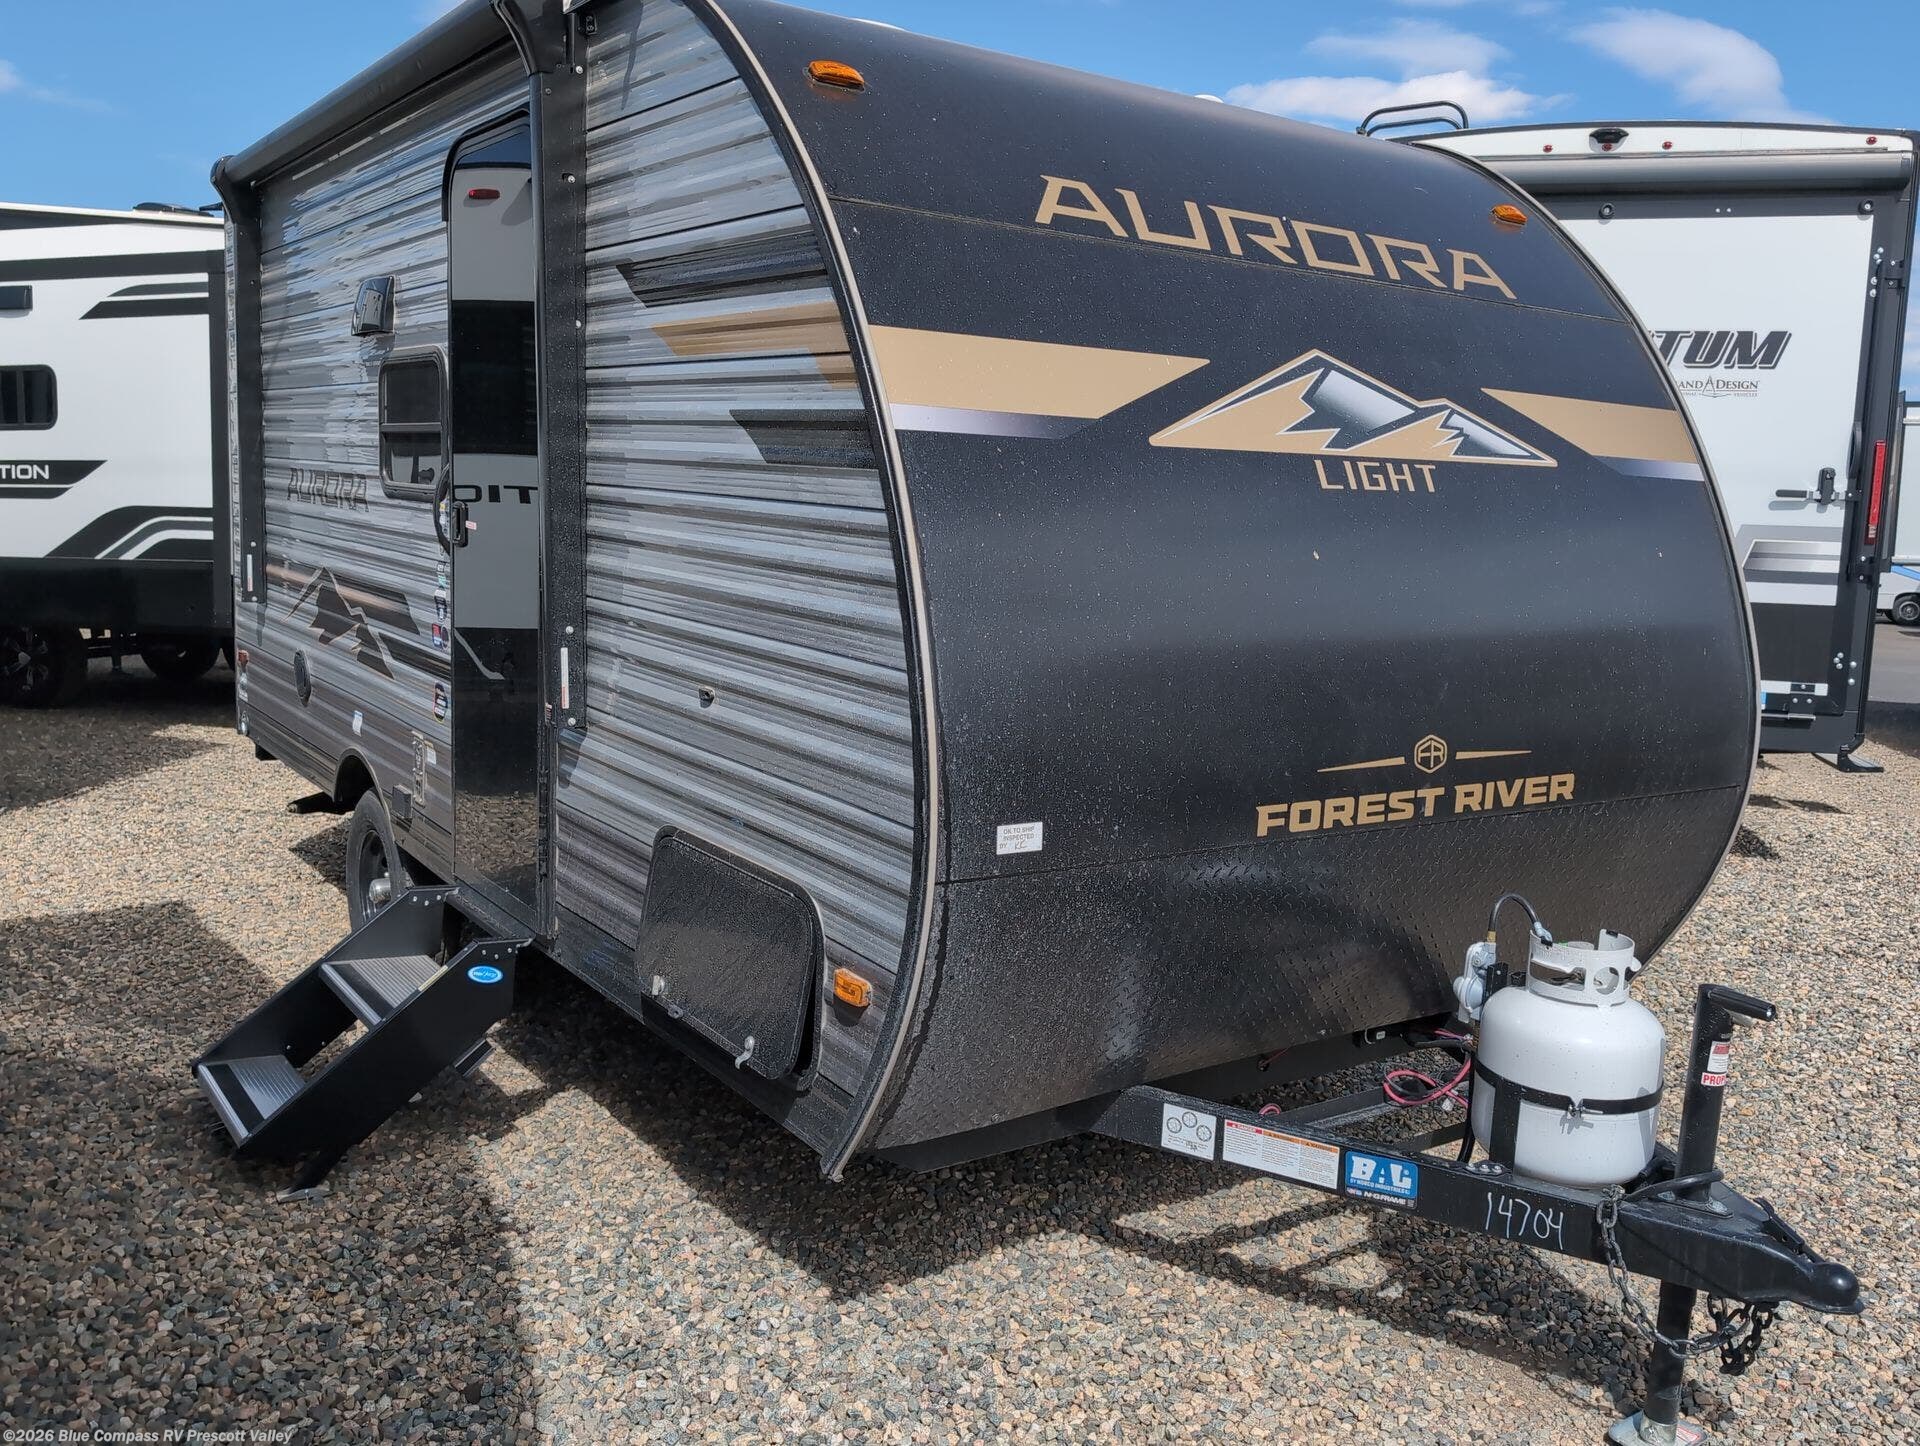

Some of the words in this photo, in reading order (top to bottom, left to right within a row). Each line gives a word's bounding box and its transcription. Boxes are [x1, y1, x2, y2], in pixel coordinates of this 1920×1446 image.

[1035, 174, 1517, 299] AURORA
[1649, 330, 1793, 369] TUM
[1676, 380, 1703, 390] AND
[1716, 379, 1758, 390] DESIGN
[0, 464, 50, 480] TION
[286, 467, 370, 512] AURORA
[1314, 459, 1436, 493] LIGHT
[1256, 787, 1445, 837] FOREST
[1454, 773, 1575, 813] RIVER
[1485, 1192, 1564, 1250] 14704
